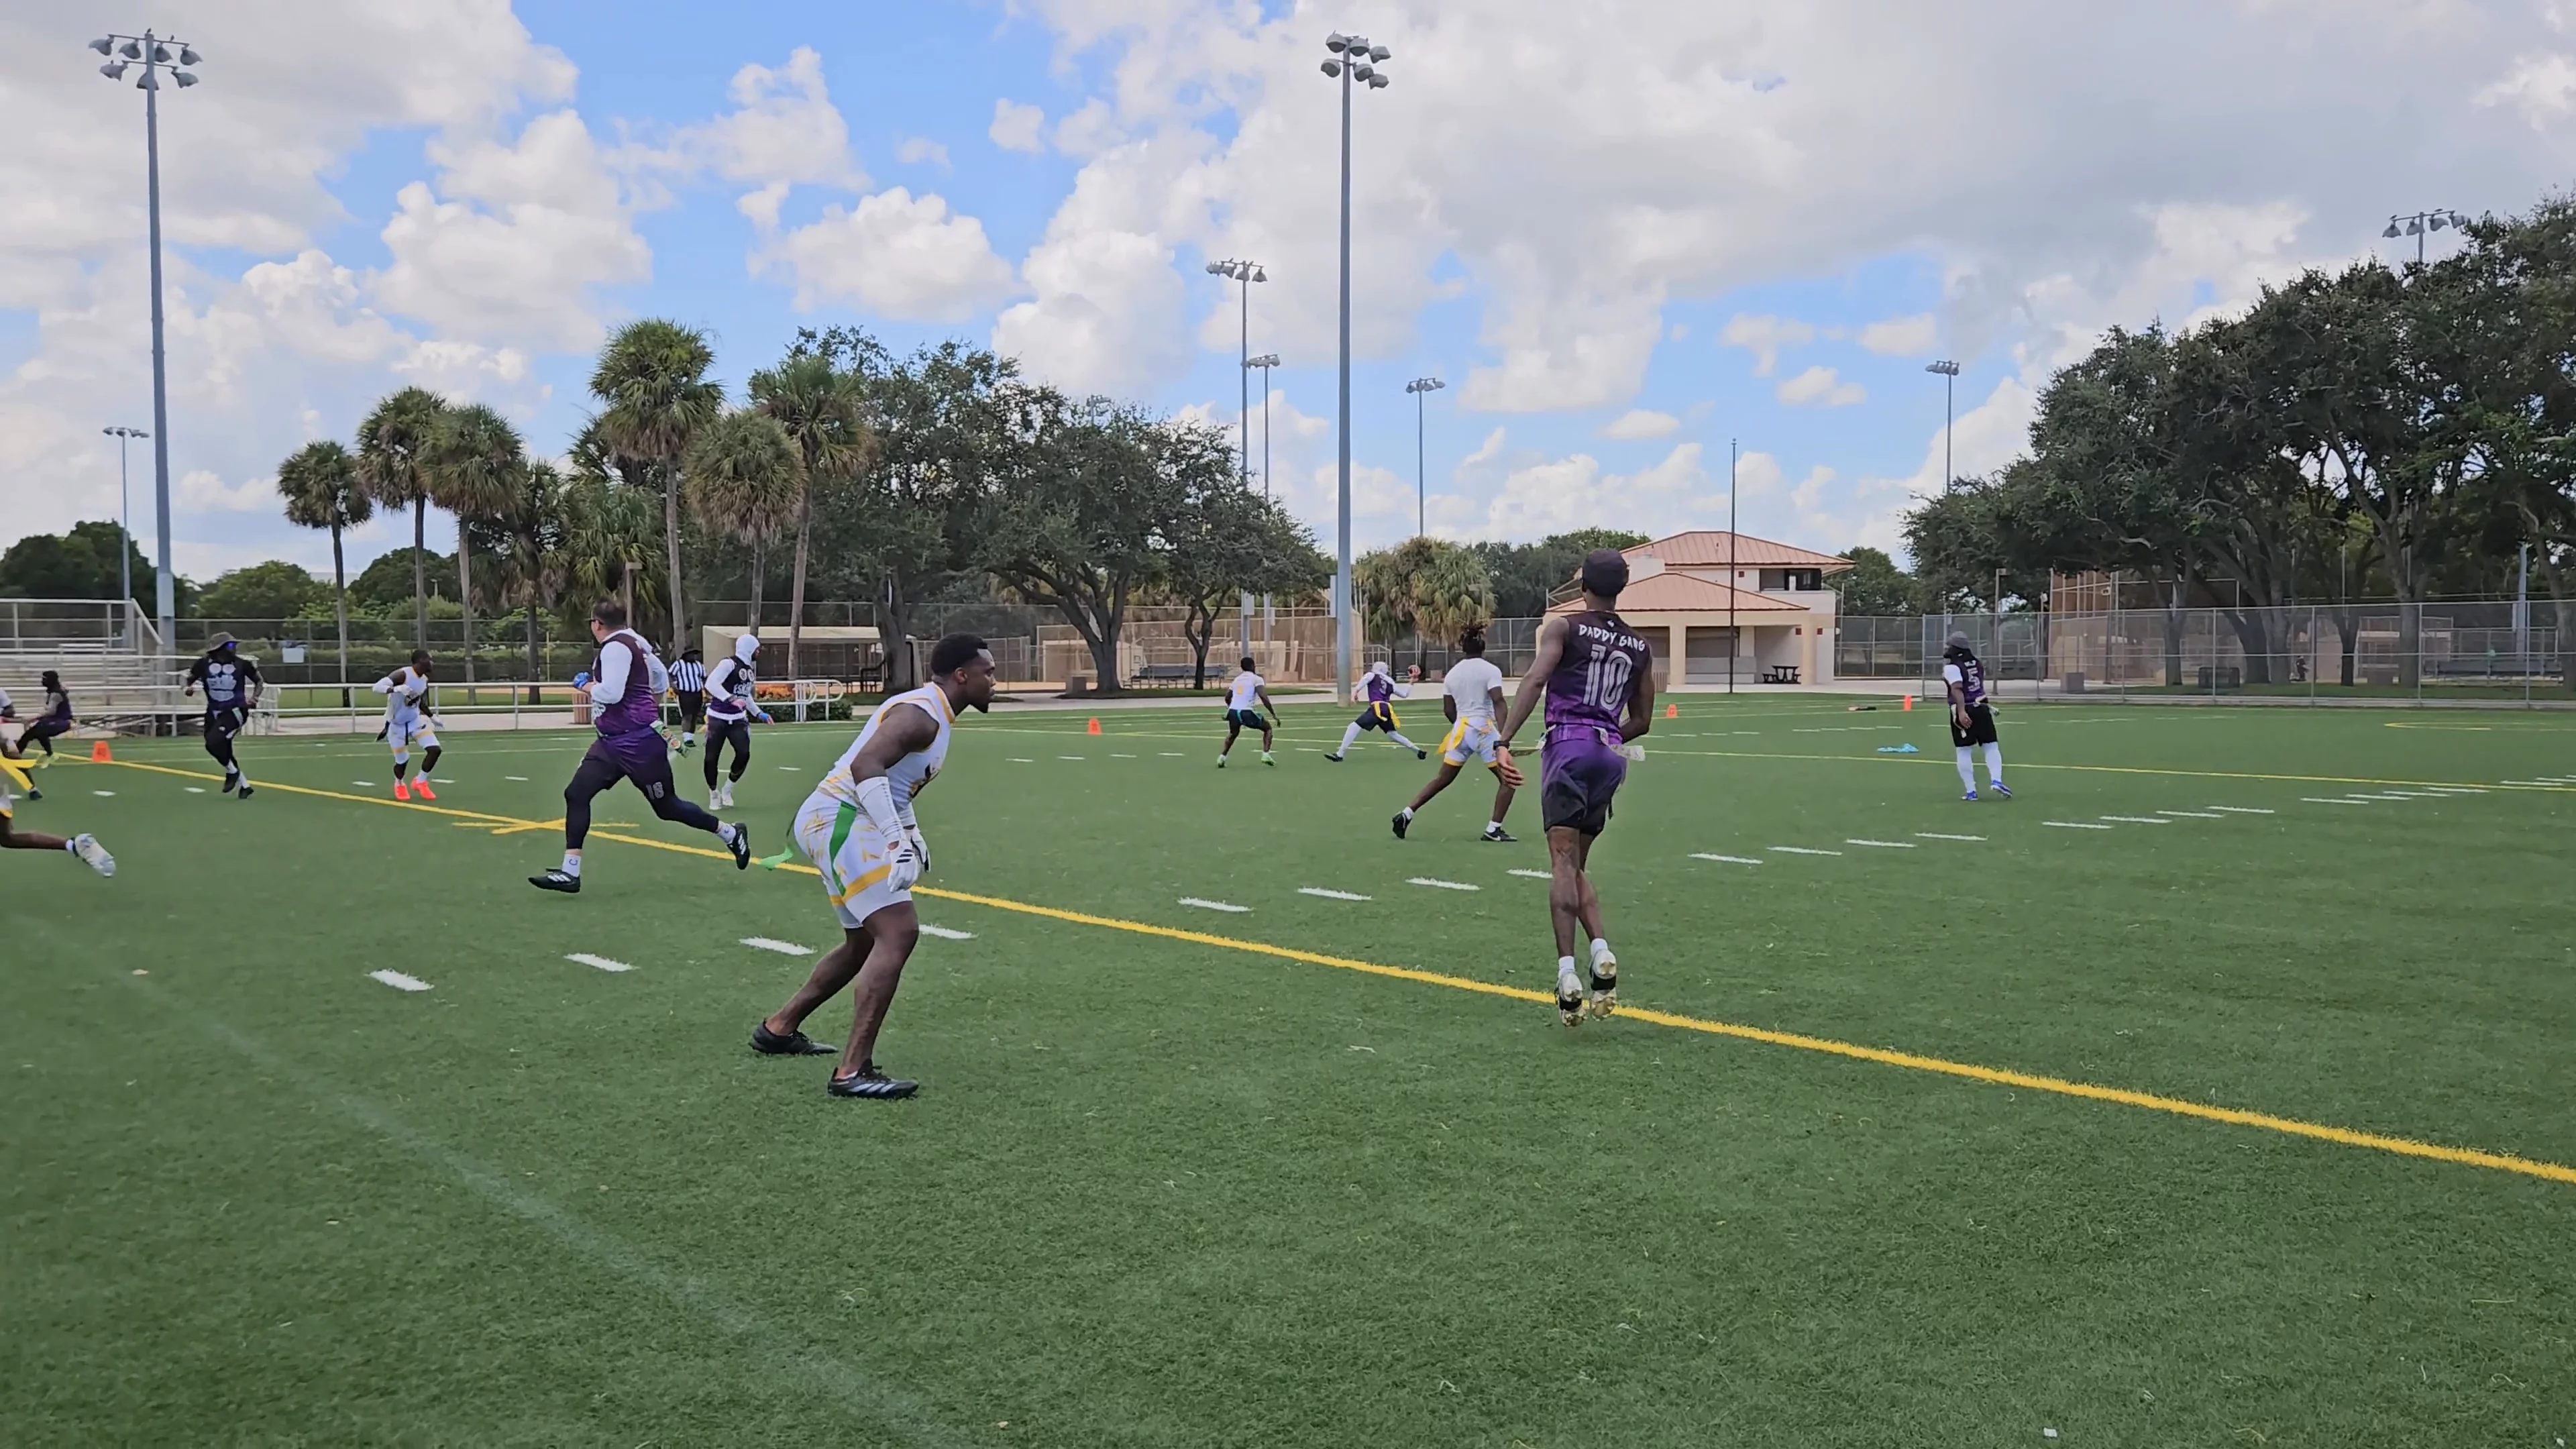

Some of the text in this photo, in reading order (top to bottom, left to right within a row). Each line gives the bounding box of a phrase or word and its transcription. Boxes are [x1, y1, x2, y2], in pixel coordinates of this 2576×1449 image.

[1578, 623, 1646, 652] DADDY GANG
[1582, 643, 1633, 711] 10
[1966, 667, 1981, 692] 5
